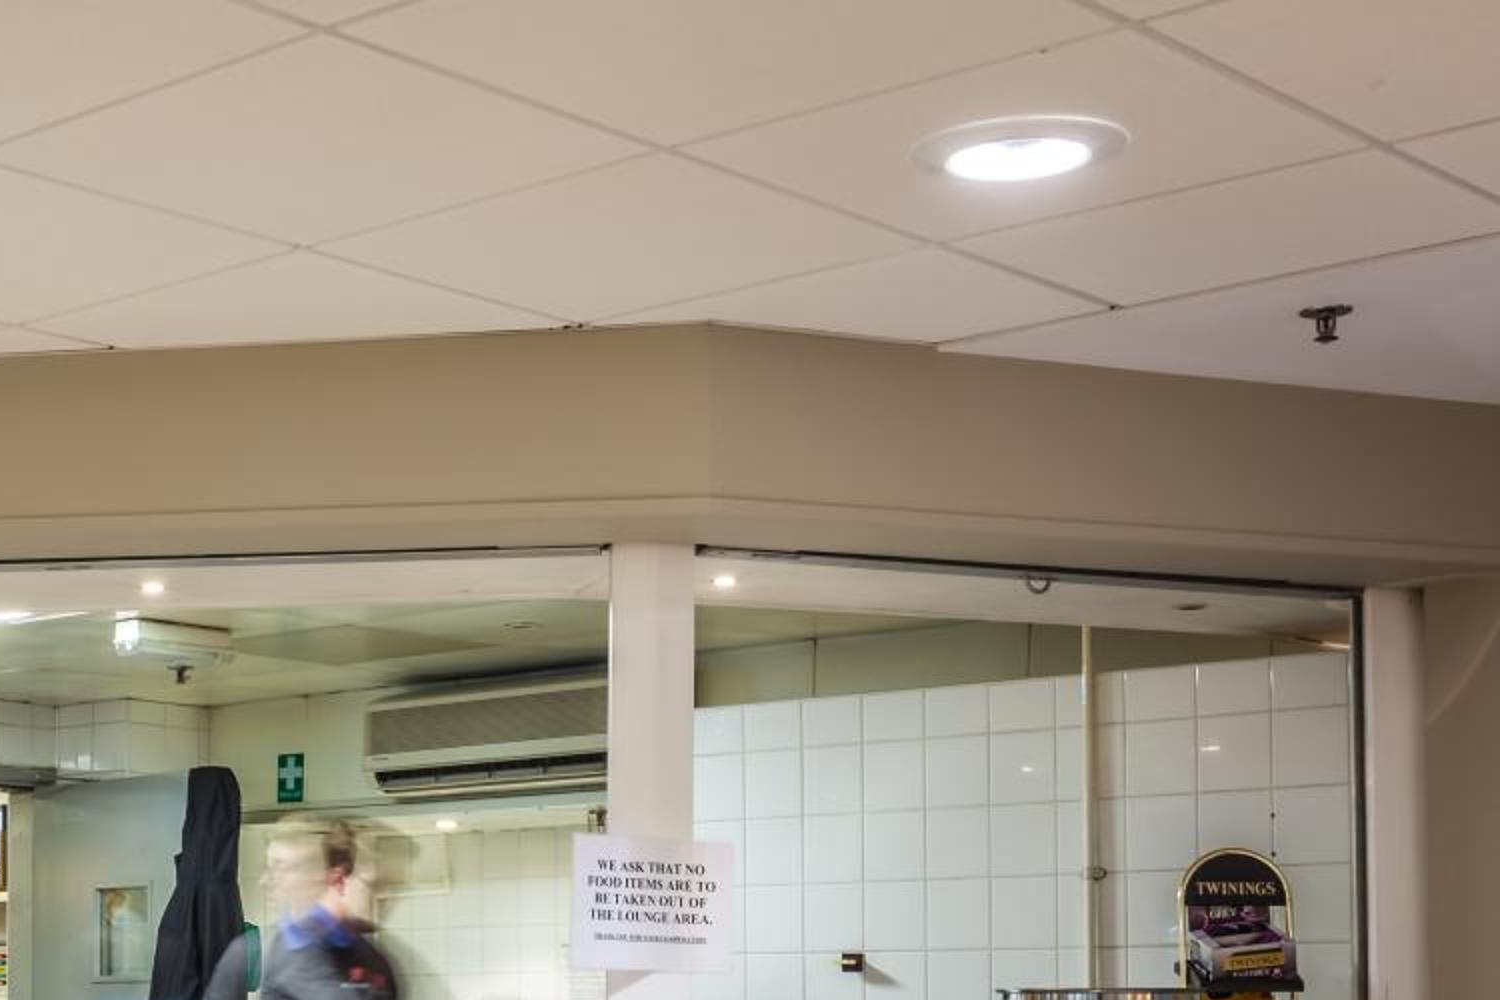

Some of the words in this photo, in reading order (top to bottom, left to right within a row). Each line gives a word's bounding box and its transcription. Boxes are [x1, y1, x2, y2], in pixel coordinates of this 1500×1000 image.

[597, 859, 617, 871] WE
[620, 861, 645, 873] ASK
[648, 862, 682, 875] THAT
[685, 864, 705, 876] NO
[587, 875, 622, 889] FOOD
[625, 877, 663, 891] ITEMS
[666, 879, 693, 892] ARE
[696, 881, 717, 893] TO
[1196, 881, 1277, 896] TWININGS
[595, 893, 611, 904] BE
[614, 894, 657, 907] TAKEN
[659, 896, 684, 908] OUT
[689, 897, 708, 909] OF
[590, 909, 616, 921] THE
[618, 910, 669, 924] LOUNGE
[674, 913, 713, 926] AREA.
